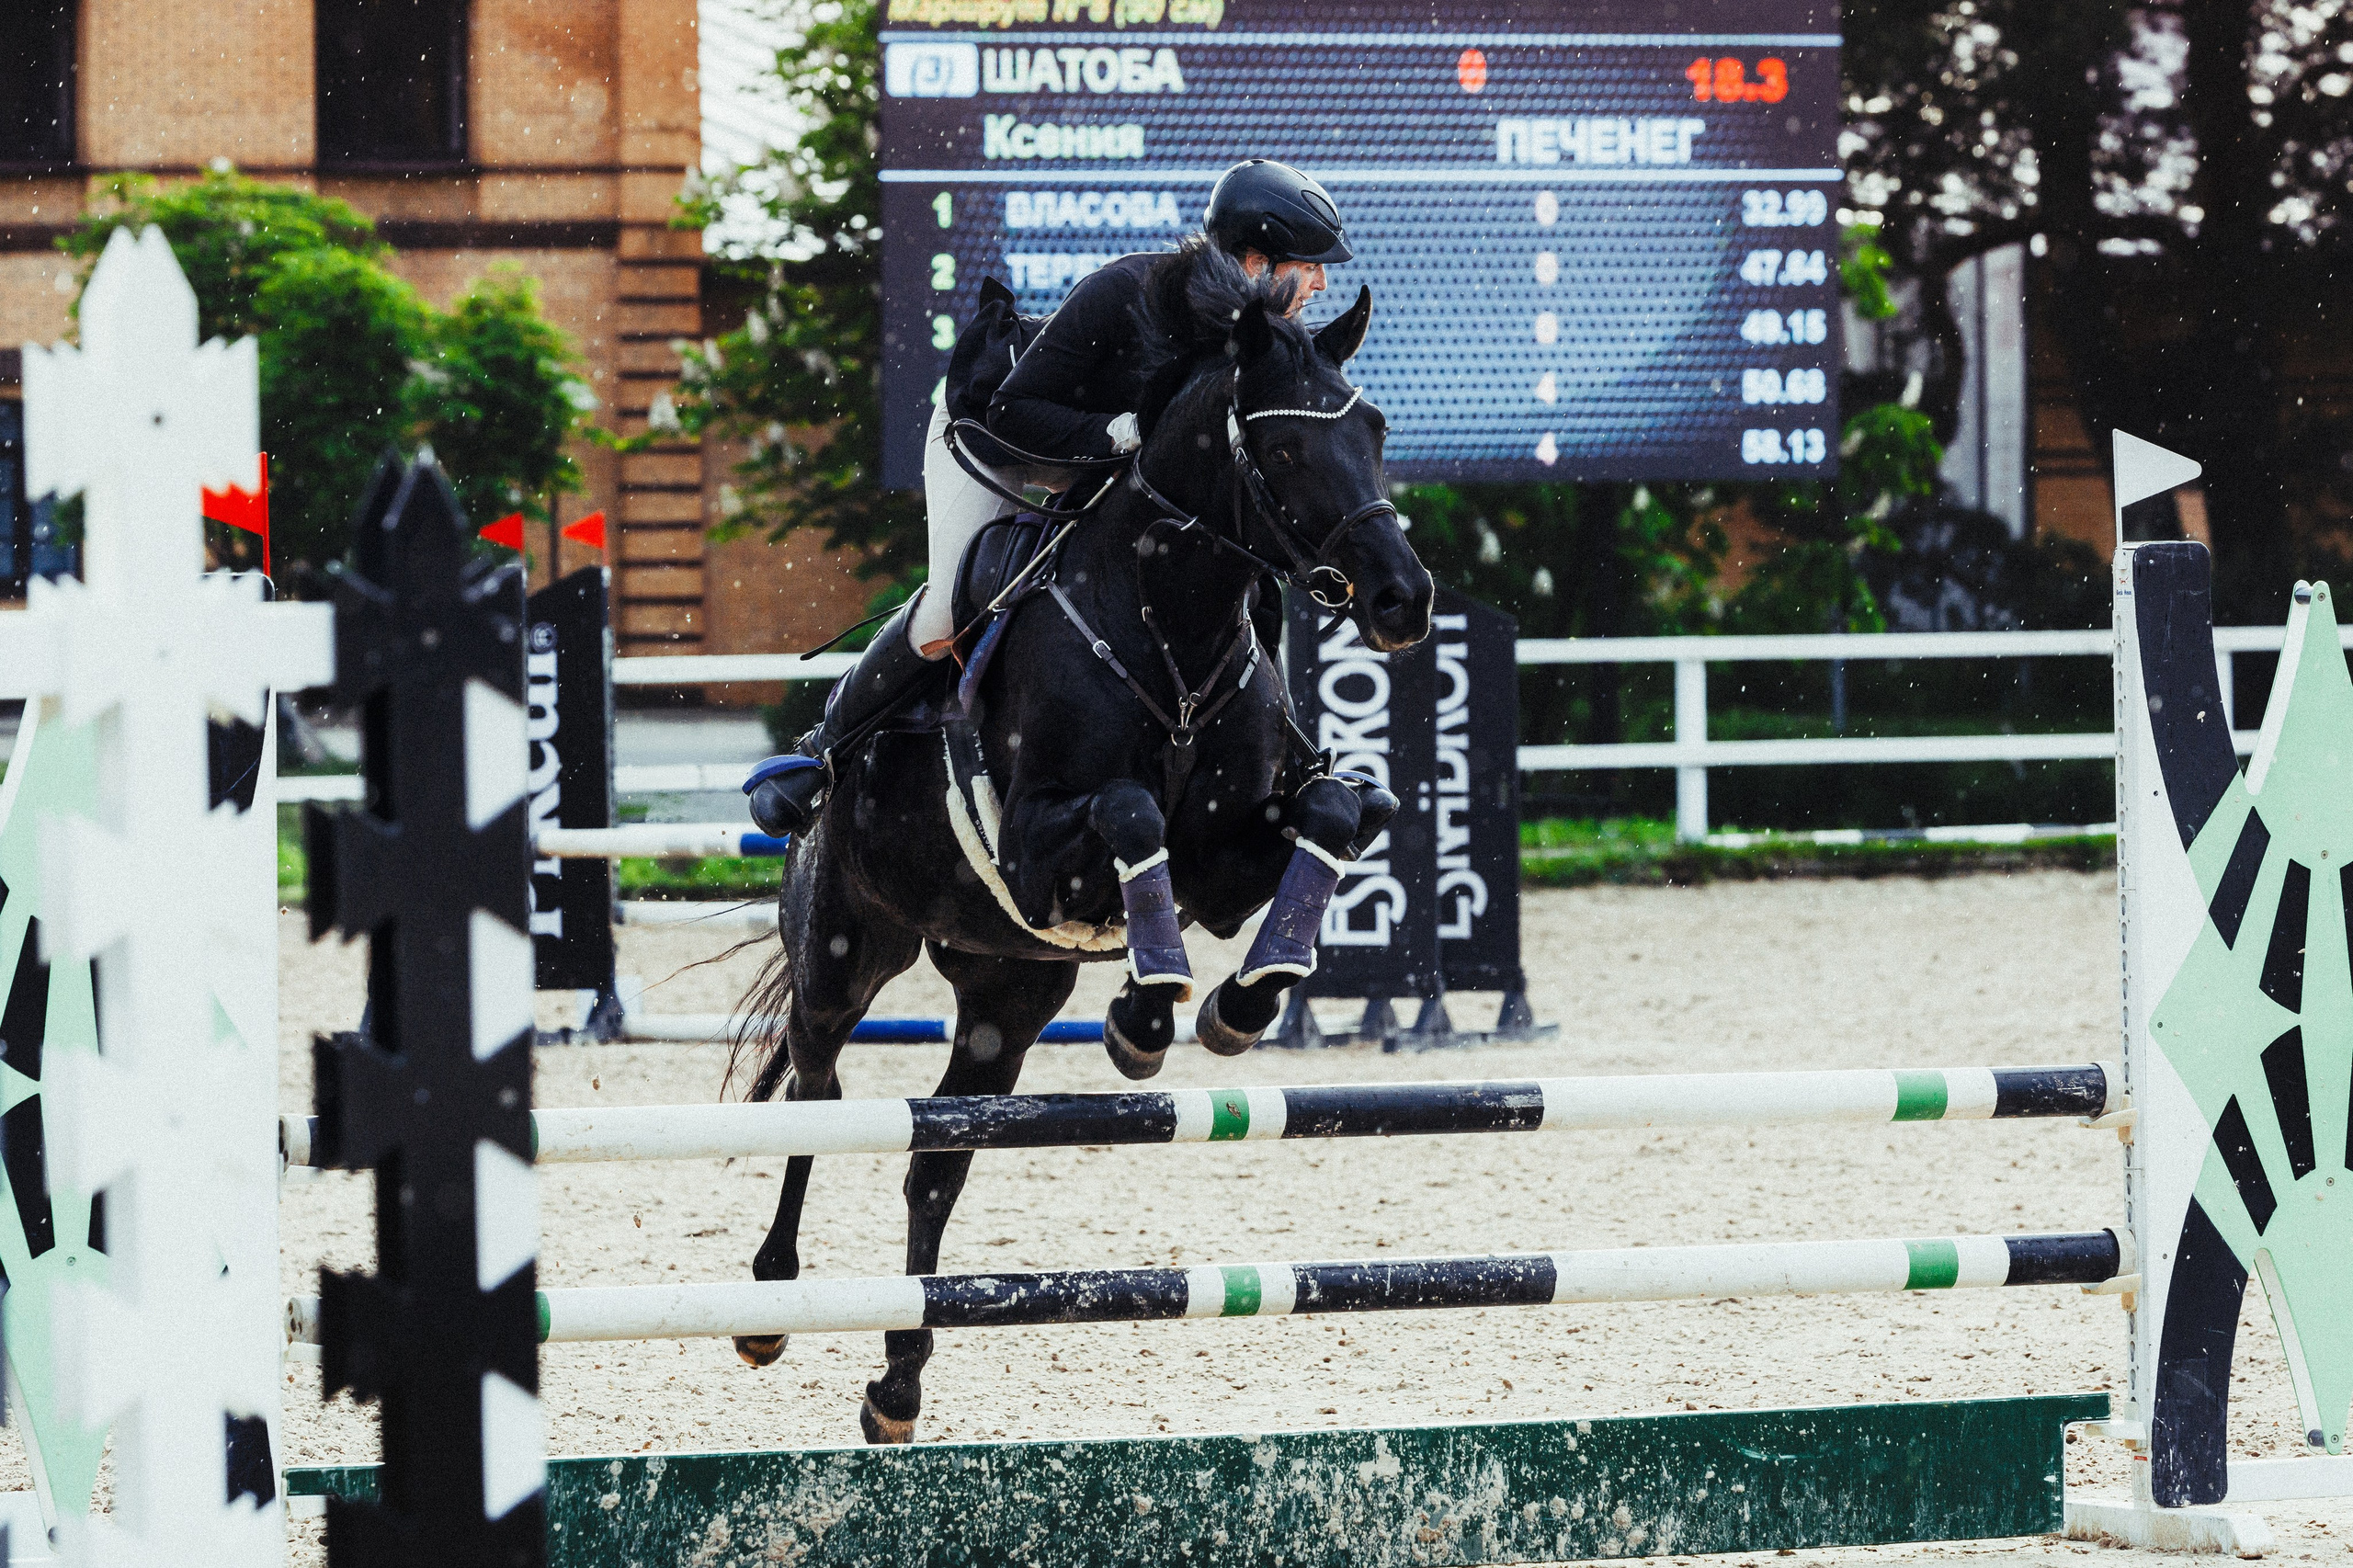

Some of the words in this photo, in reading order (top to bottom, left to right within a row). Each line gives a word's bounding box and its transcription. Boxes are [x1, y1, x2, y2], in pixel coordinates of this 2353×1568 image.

[983, 47, 1186, 94] ШАТОБА
[983, 113, 1145, 159] Ксения
[1495, 118, 1706, 165] ПЕЧЕНЕГ
[931, 191, 953, 229] 1
[1005, 191, 1181, 228] ВЛАСОВА
[931, 253, 956, 291] 2
[931, 314, 956, 351] 3
